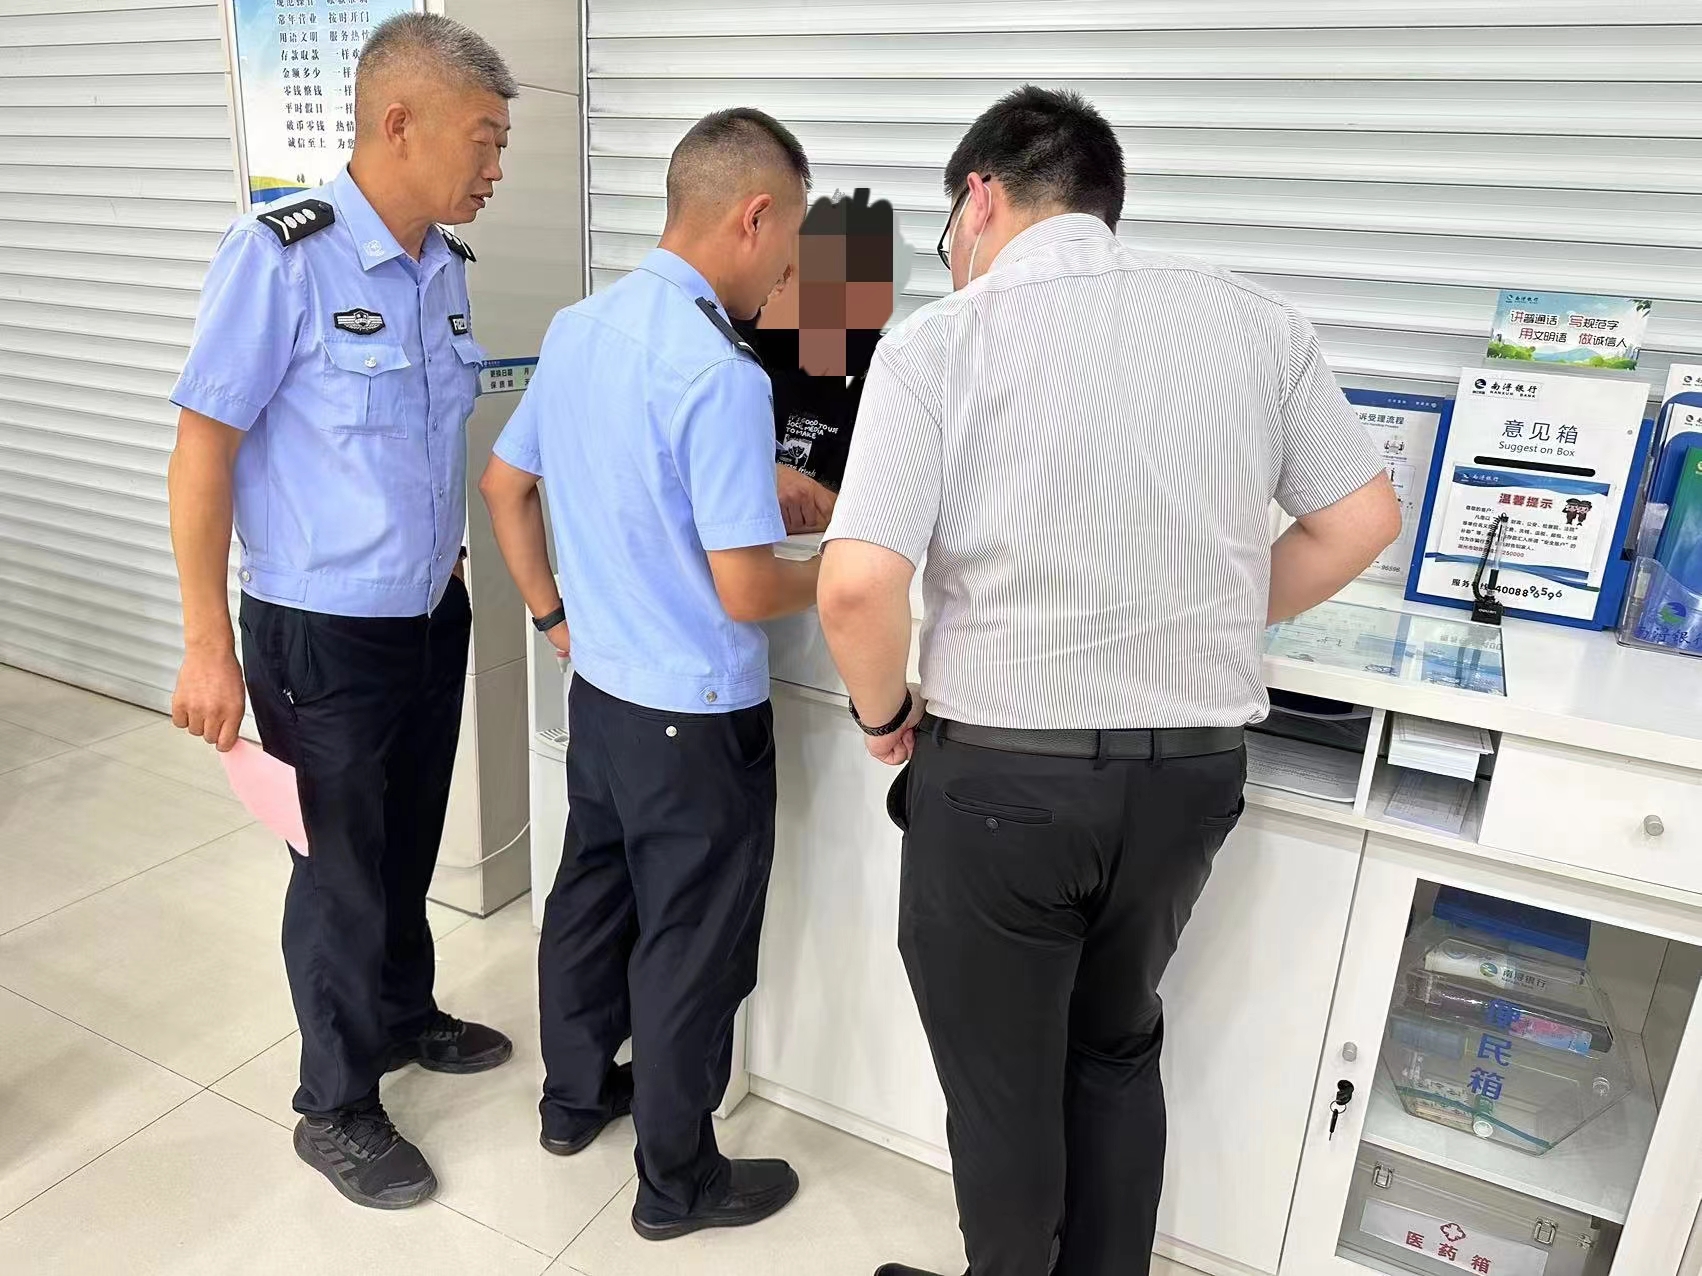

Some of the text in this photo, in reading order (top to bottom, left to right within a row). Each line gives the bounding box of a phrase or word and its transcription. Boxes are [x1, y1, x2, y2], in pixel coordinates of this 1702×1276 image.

[278, 11, 369, 25] 常年营业 按时开门
[279, 31, 318, 43] 用语文明
[280, 49, 320, 61] 存款取款
[282, 67, 321, 79] 金额多少
[283, 85, 322, 96] 零钱整钱
[284, 103, 323, 114] 平时假日
[1510, 310, 1620, 330] 讲普通话 写规范字
[1518, 327, 1627, 348] 用文明语 做诚信人
[1491, 382, 1537, 393] 南浔银行
[1355, 412, 1405, 425] 诉受理流程
[795, 430, 817, 439] MAKE
[1502, 419, 1579, 445] 意见箱
[1498, 441, 1537, 454] Suggest
[1556, 447, 1575, 456] Box
[1497, 493, 1553, 509] 温馨提示
[1406, 1230, 1491, 1274] 医药箱
